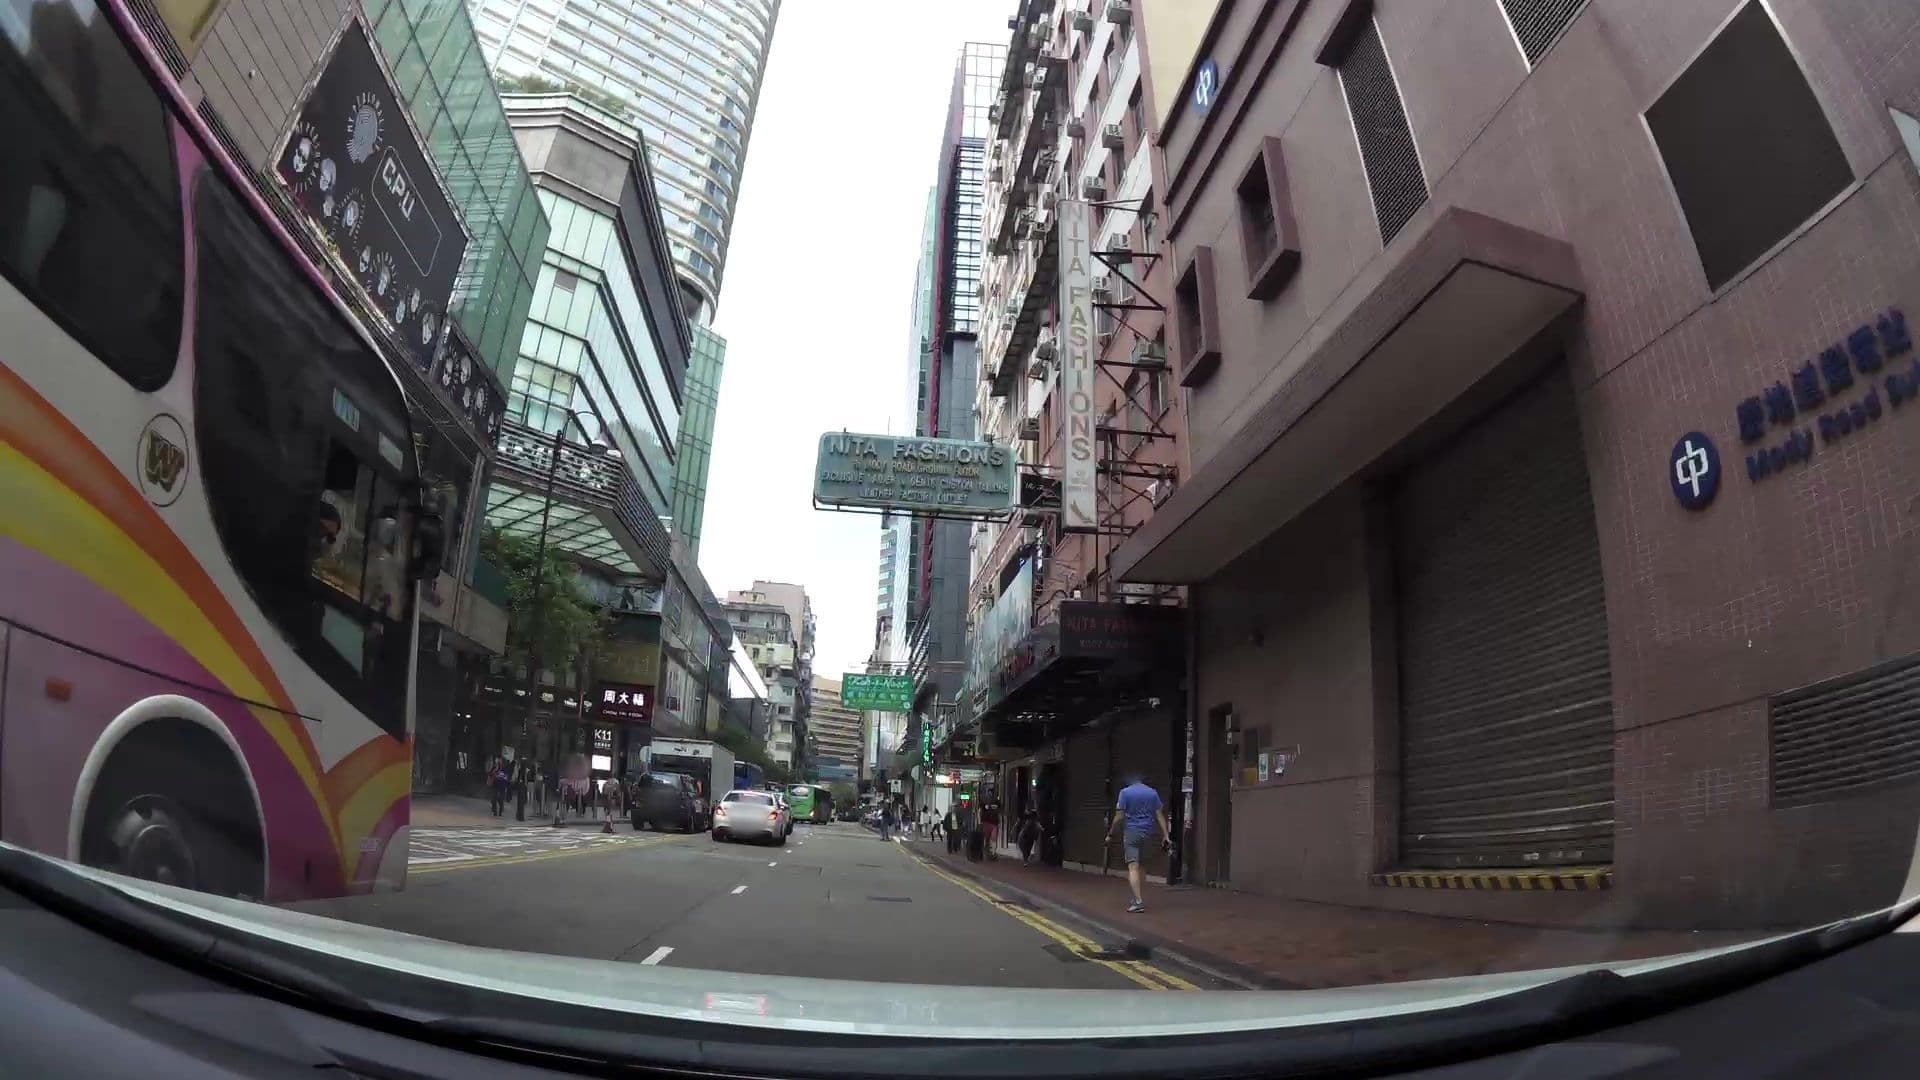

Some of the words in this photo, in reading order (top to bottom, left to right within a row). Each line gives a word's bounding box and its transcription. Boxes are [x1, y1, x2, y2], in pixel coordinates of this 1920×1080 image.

[1067, 203, 1085, 276] NITA
[1069, 286, 1091, 462] FASHIONS
[1745, 428, 1814, 484] Mody
[1818, 384, 1882, 443] Road
[828, 436, 877, 457] NITA
[893, 441, 1004, 467] FASHIONS
[892, 459, 914, 473] ROAD
[603, 689, 645, 707] 周大福
[594, 728, 612, 741] K11
